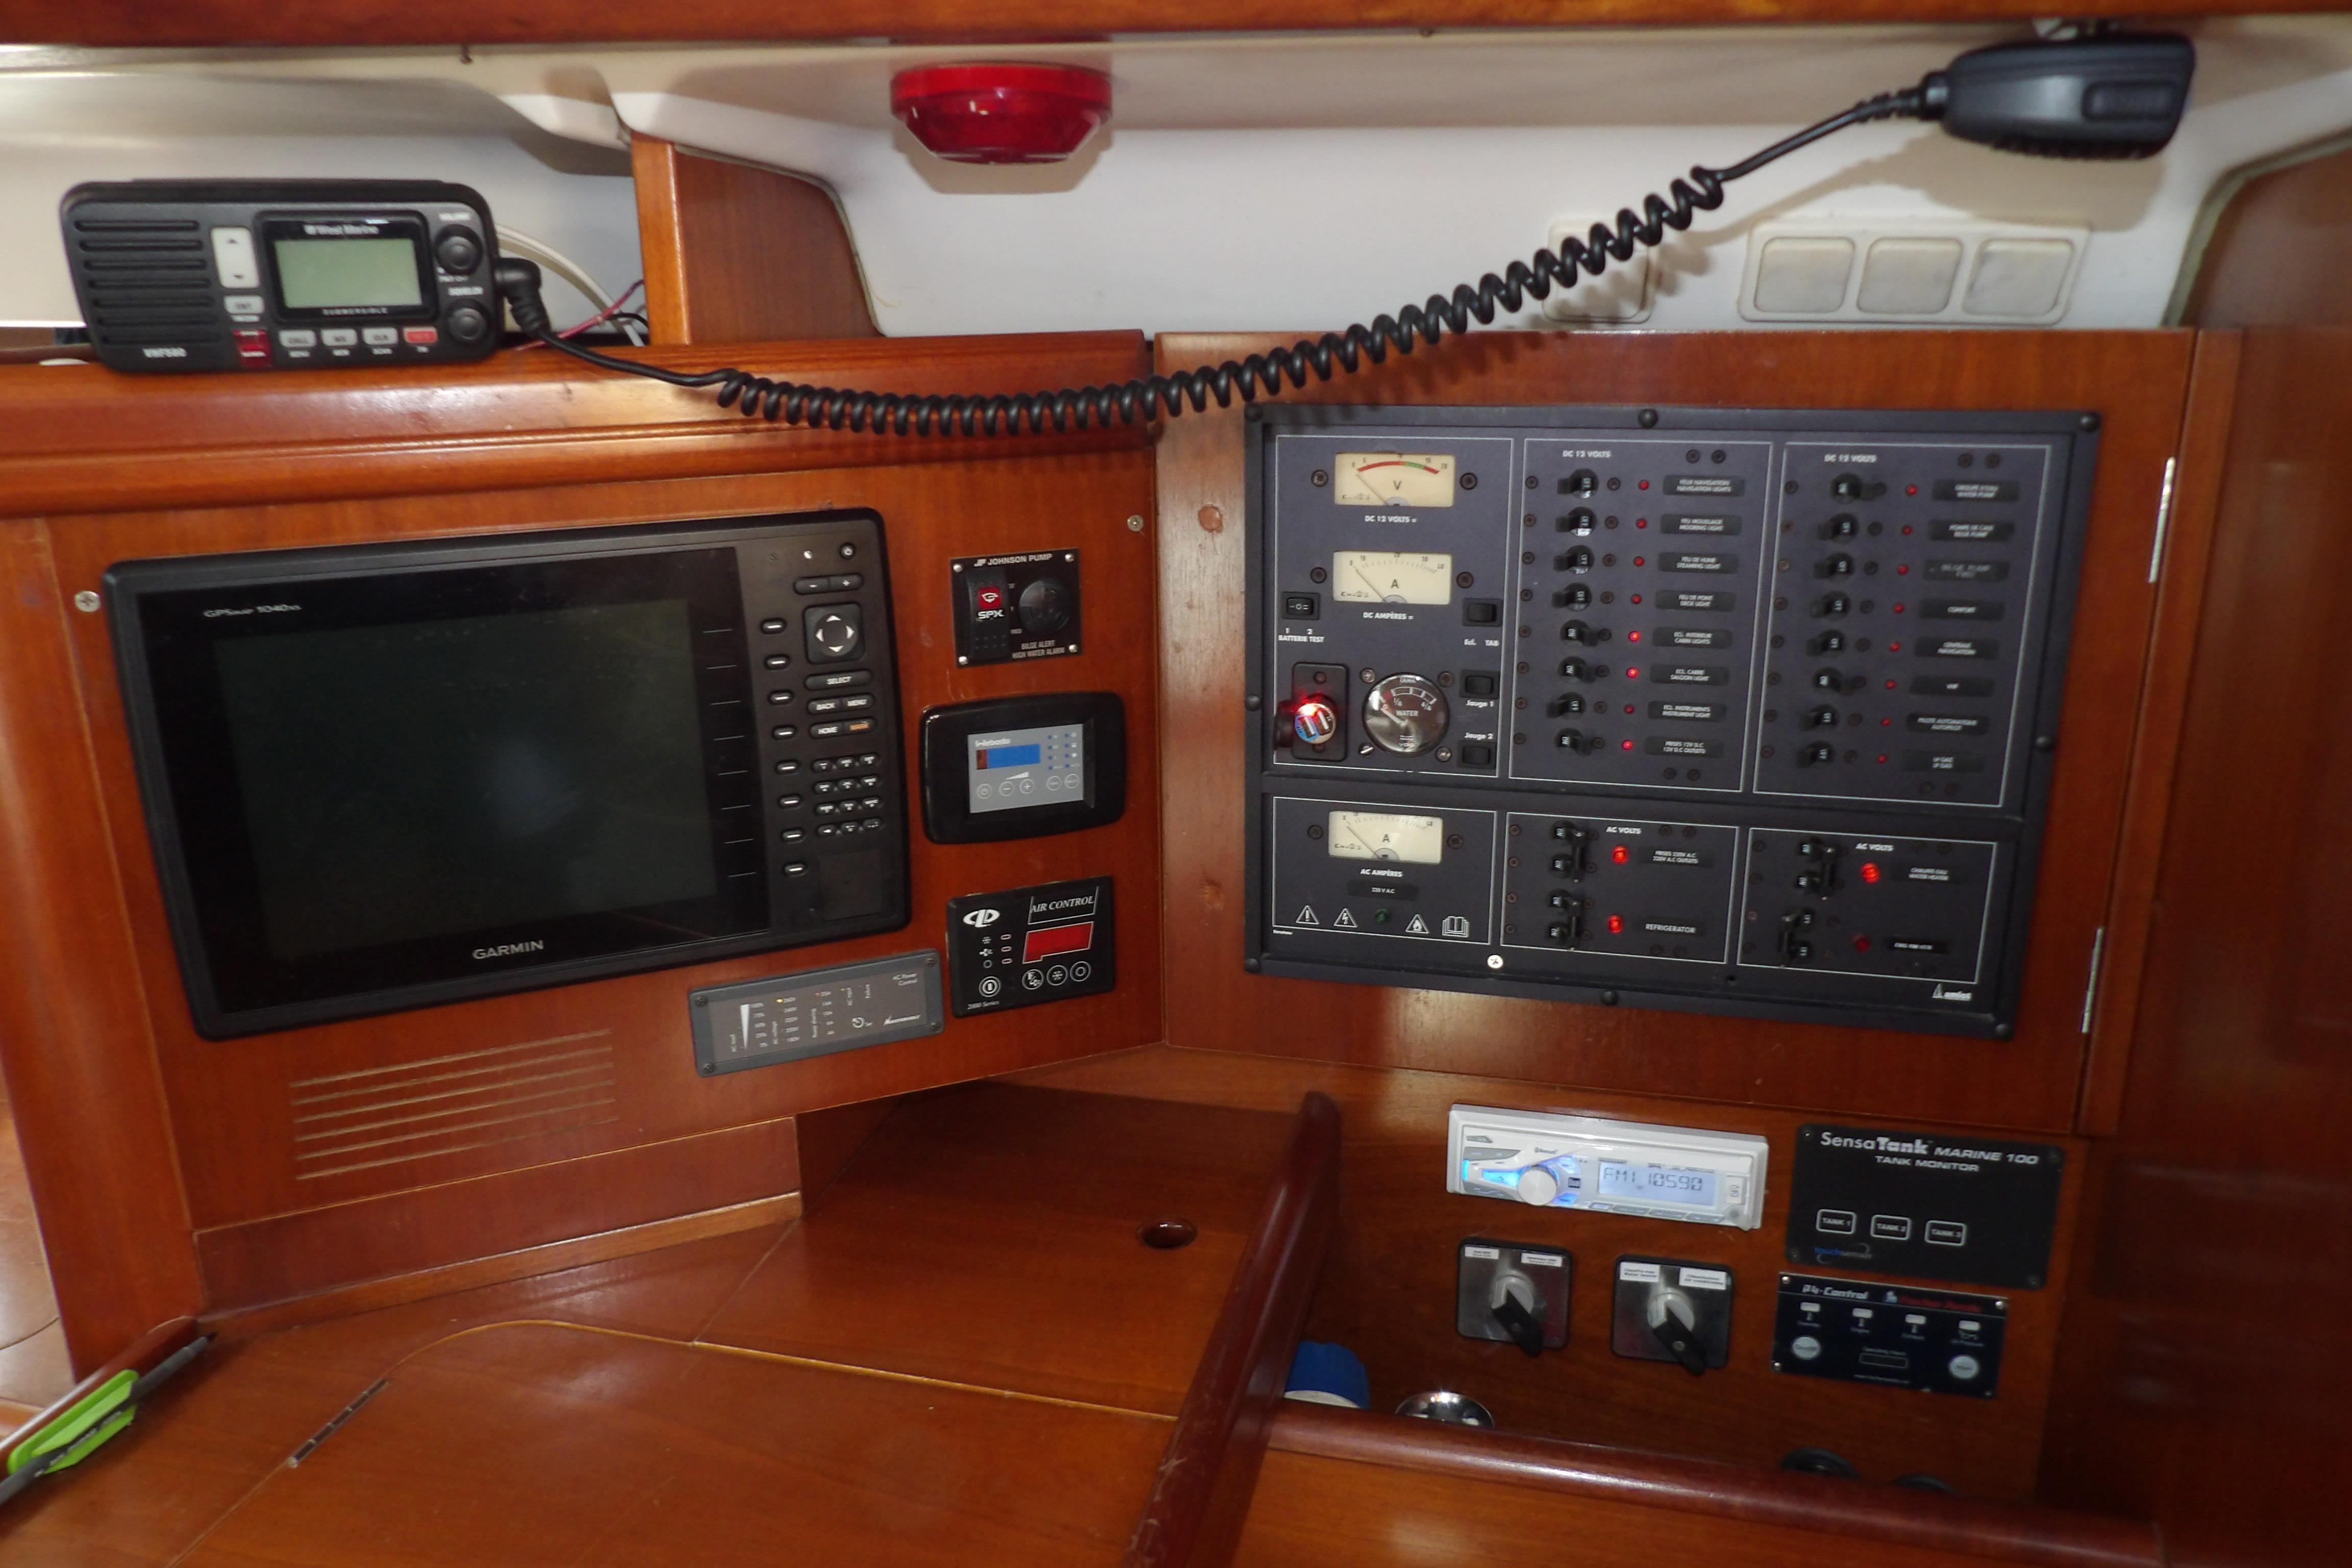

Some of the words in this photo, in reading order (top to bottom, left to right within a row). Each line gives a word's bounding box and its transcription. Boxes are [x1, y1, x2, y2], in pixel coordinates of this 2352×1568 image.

[1824, 454, 1836, 462] DC
[1851, 454, 1878, 463] VOLTS
[1393, 480, 1402, 491] V
[988, 556, 1026, 566] JOHNSON
[1028, 553, 1053, 562] PUMP
[1390, 579, 1399, 589] A
[977, 609, 1004, 619] SPX
[1046, 647, 1065, 655] ALARM
[827, 676, 852, 685] SELECT
[816, 702, 835, 710] BACK
[847, 699, 867, 707] MENU
[818, 726, 838, 734] HOME
[1382, 834, 1390, 842] A
[1869, 844, 1895, 852] VOLTS
[1030, 903, 1047, 913] AIR
[1049, 896, 1094, 910] CONTROL
[1645, 923, 1696, 934] REFRIGERATOR
[472, 940, 544, 960] GARMIN
[1820, 1132, 1928, 1155] SensaTank
[1934, 1147, 2002, 1161] MARINE
[2006, 1154, 2039, 1165] 100
[1875, 1156, 1912, 1167] TANK
[1914, 1159, 1980, 1172] MONITOR
[1603, 1167, 1635, 1182] FM1
[1648, 1173, 1703, 1191] 10590
[1822, 1217, 1845, 1226] TANK
[1877, 1223, 1899, 1232] TANK
[1930, 1229, 1954, 1237] TANK
